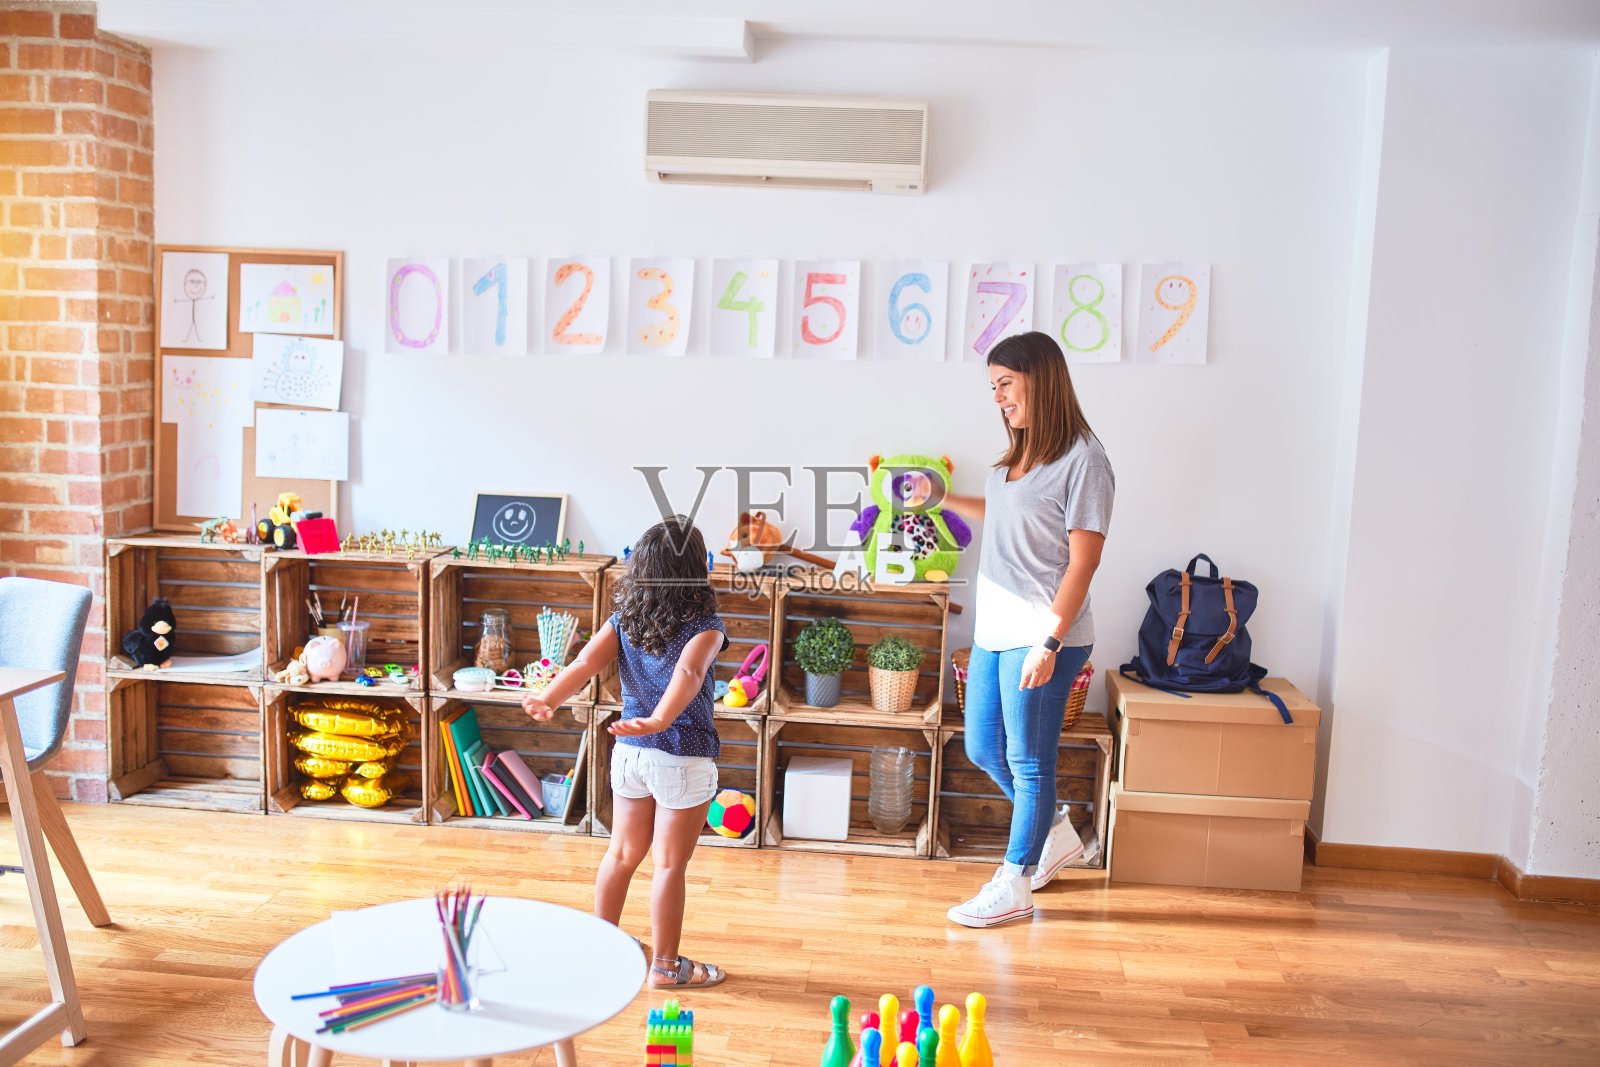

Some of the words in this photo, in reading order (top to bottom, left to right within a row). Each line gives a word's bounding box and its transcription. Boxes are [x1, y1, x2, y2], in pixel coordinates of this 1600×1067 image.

[390, 263, 443, 349] 0
[473, 263, 507, 346] 1
[553, 263, 603, 346] 2
[636, 267, 681, 348] 3
[717, 271, 766, 348] 4
[801, 272, 847, 346] 5
[887, 272, 933, 346] 6
[973, 281, 1027, 355] 7
[1060, 274, 1110, 353] 8
[1151, 274, 1197, 353] 9
